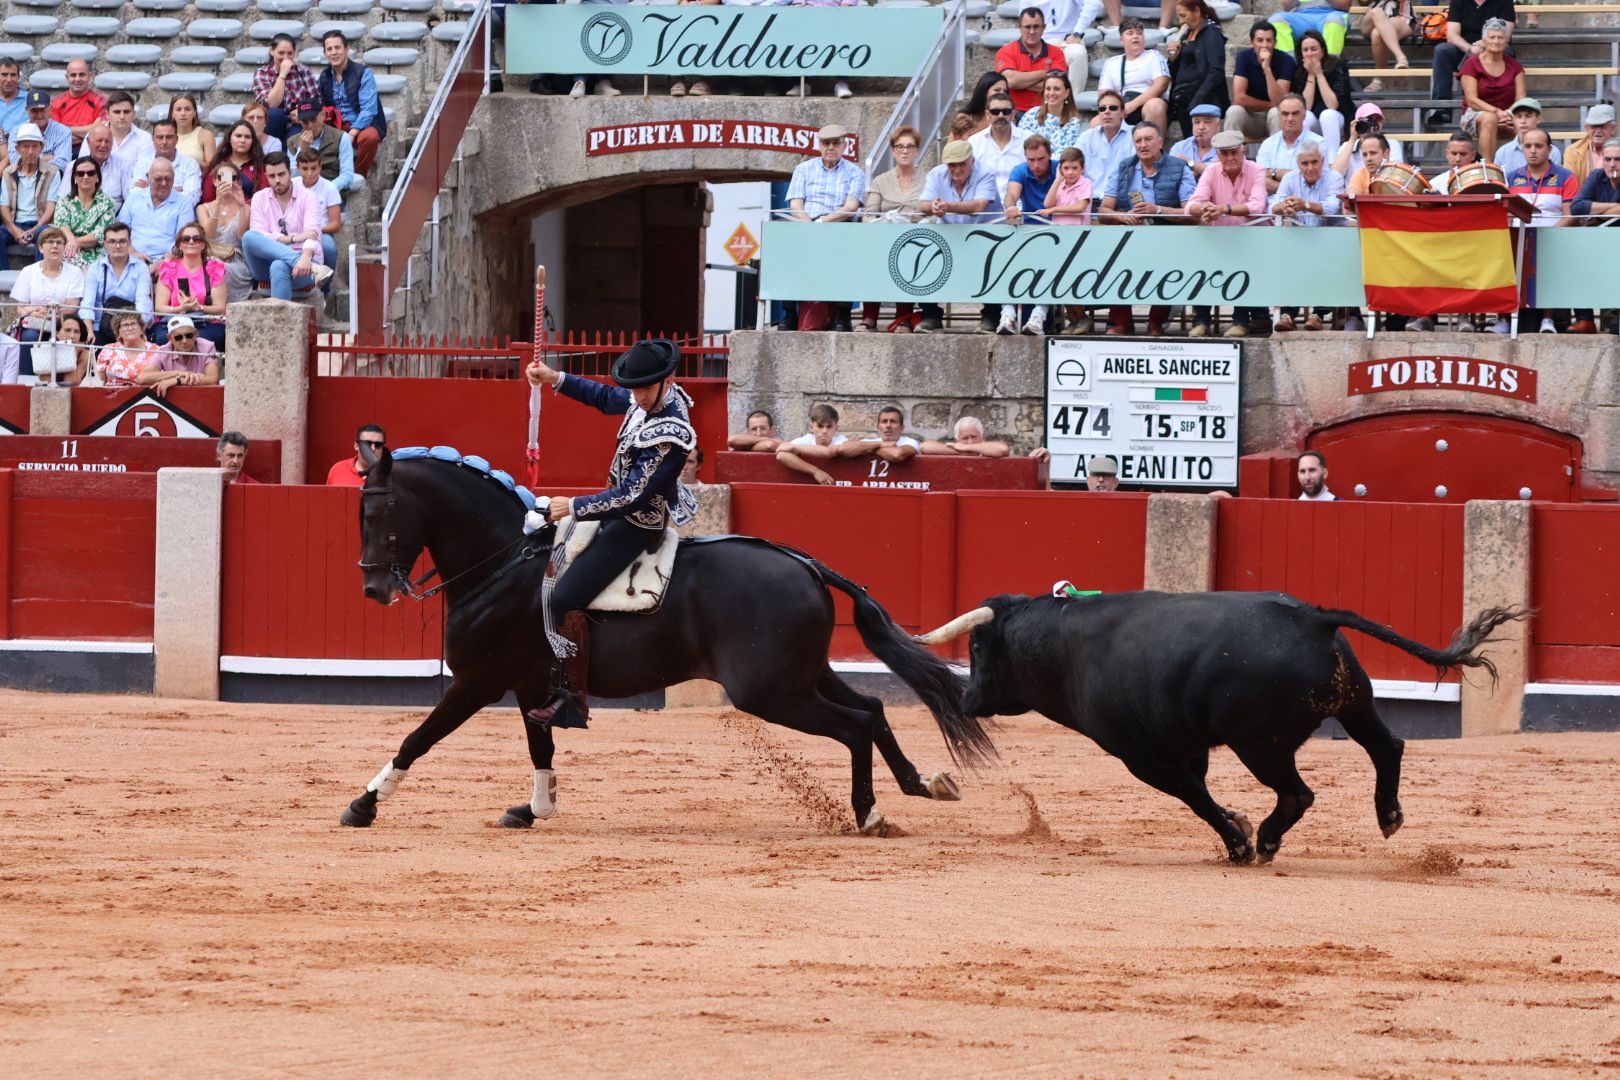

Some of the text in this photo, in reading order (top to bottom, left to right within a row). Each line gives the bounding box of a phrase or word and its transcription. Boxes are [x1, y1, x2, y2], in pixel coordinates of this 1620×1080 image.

[642, 13, 872, 69] Valduero
[590, 123, 856, 157] PUERTA DE ARRASTE
[965, 230, 1250, 301] Valduero
[1103, 358, 1231, 376] ANGEL SANCHEZ
[1367, 359, 1519, 393] TORILES
[1053, 406, 1111, 436] 474
[1180, 421, 1196, 432] SEP
[1198, 415, 1226, 439] 18
[60, 440, 79, 459] 11
[867, 459, 890, 478] 12
[1074, 454, 1213, 480] AEANITO
